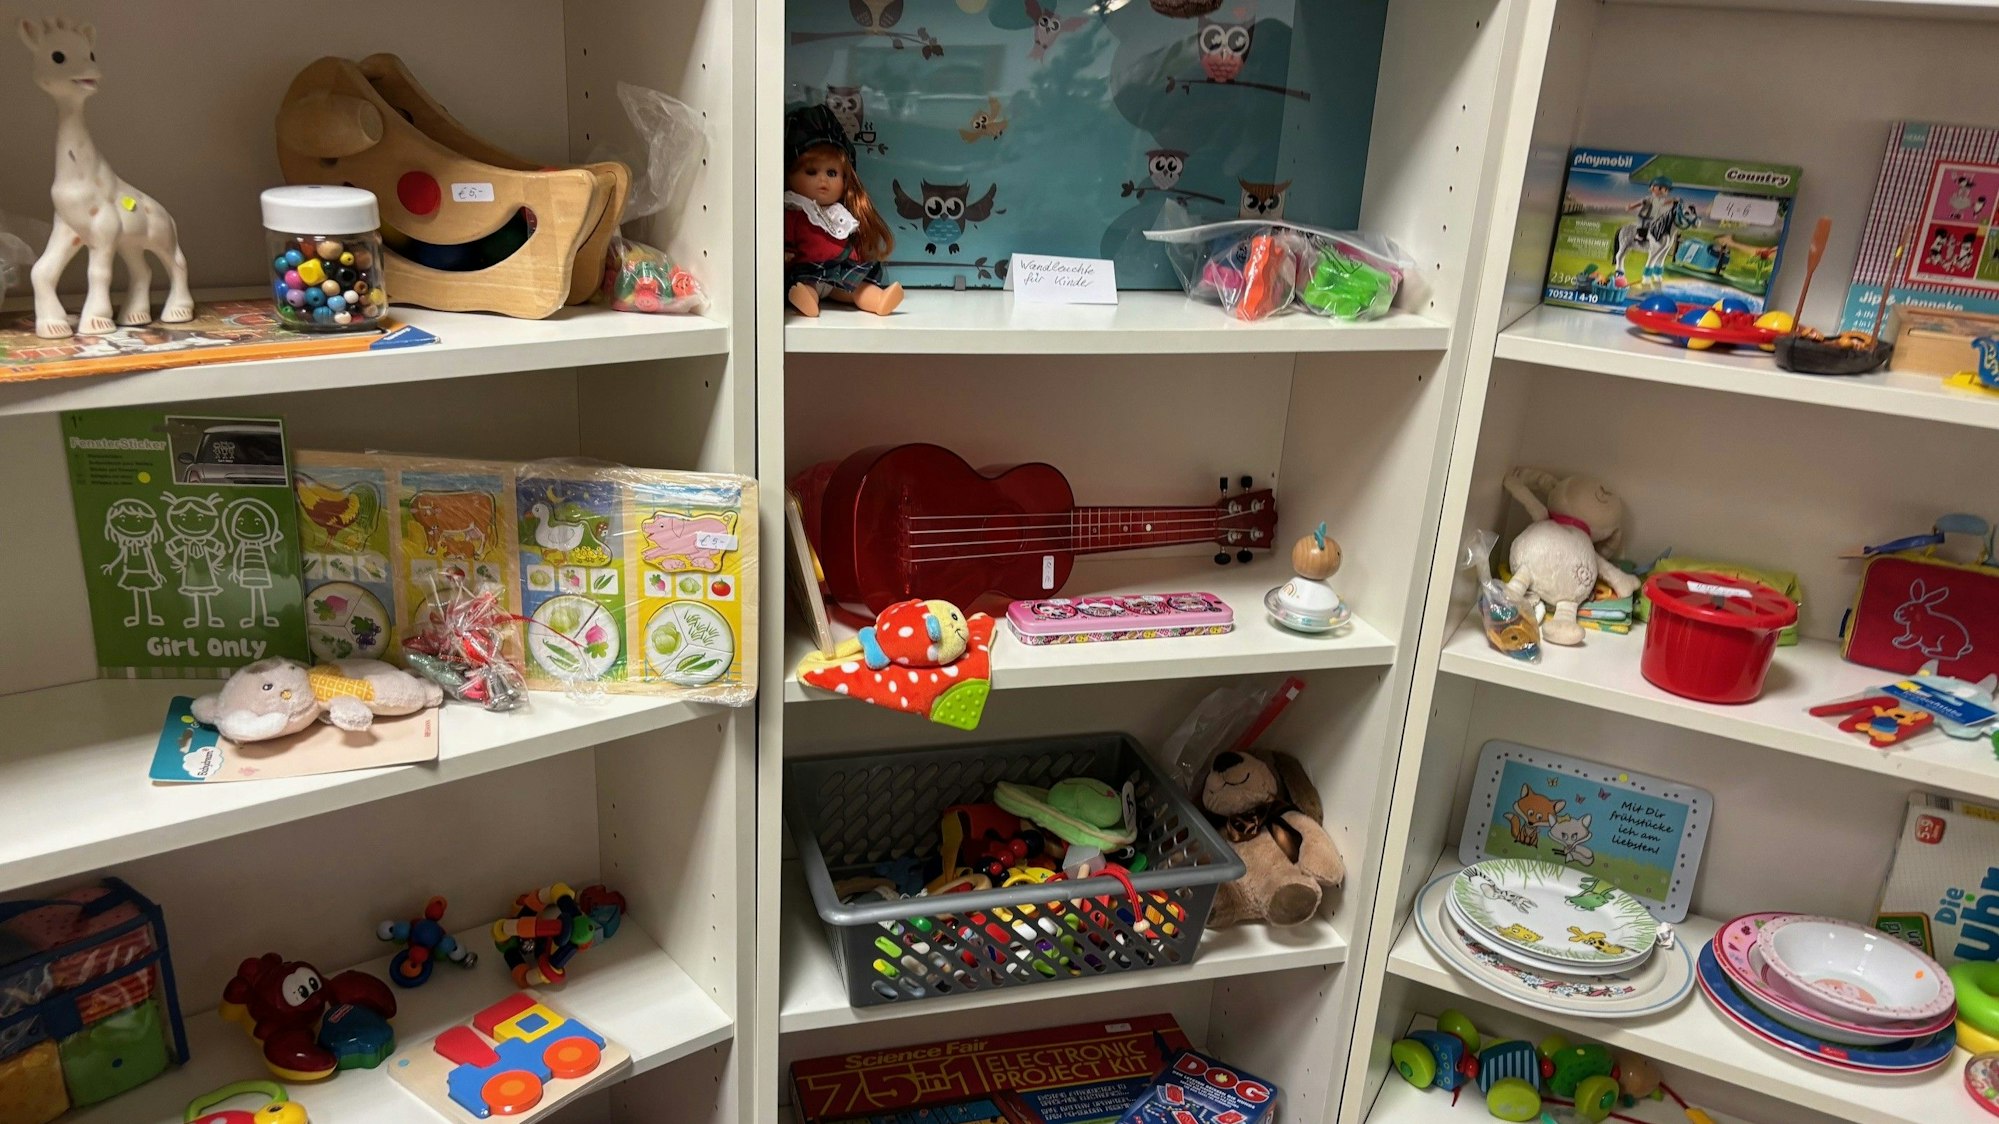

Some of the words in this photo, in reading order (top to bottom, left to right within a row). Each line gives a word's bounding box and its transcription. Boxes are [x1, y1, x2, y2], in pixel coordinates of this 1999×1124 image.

[1574, 153, 1633, 168] playmobil
[1726, 168, 1790, 187] Country
[1020, 259, 1094, 275] Wandleuchte
[1024, 272, 1044, 286] für
[1054, 275, 1094, 287] Kinder
[1549, 289, 1573, 300] 70522
[1579, 292, 1598, 303] 4-10
[1859, 291, 1881, 306] Jip
[69, 437, 167, 450] FensterSticker
[147, 637, 200, 657] Girl
[207, 637, 267, 660] Only
[1621, 801, 1643, 813] Mit
[1645, 807, 1666, 818] Dir
[1609, 810, 1674, 833] frühstücke
[1618, 824, 1638, 836] ich
[1641, 833, 1661, 842] am
[1612, 834, 1660, 854] liebsten!
[1934, 887, 1965, 926] Die
[1954, 866, 1999, 962] Uhr
[845, 1047, 942, 1069] Science
[946, 1040, 988, 1055] Fair
[986, 1039, 1144, 1073] ELECTRONIC
[993, 1062, 1101, 1089] PROJECT
[1108, 1055, 1148, 1074] KIT
[1173, 1052, 1270, 1103] DOG
